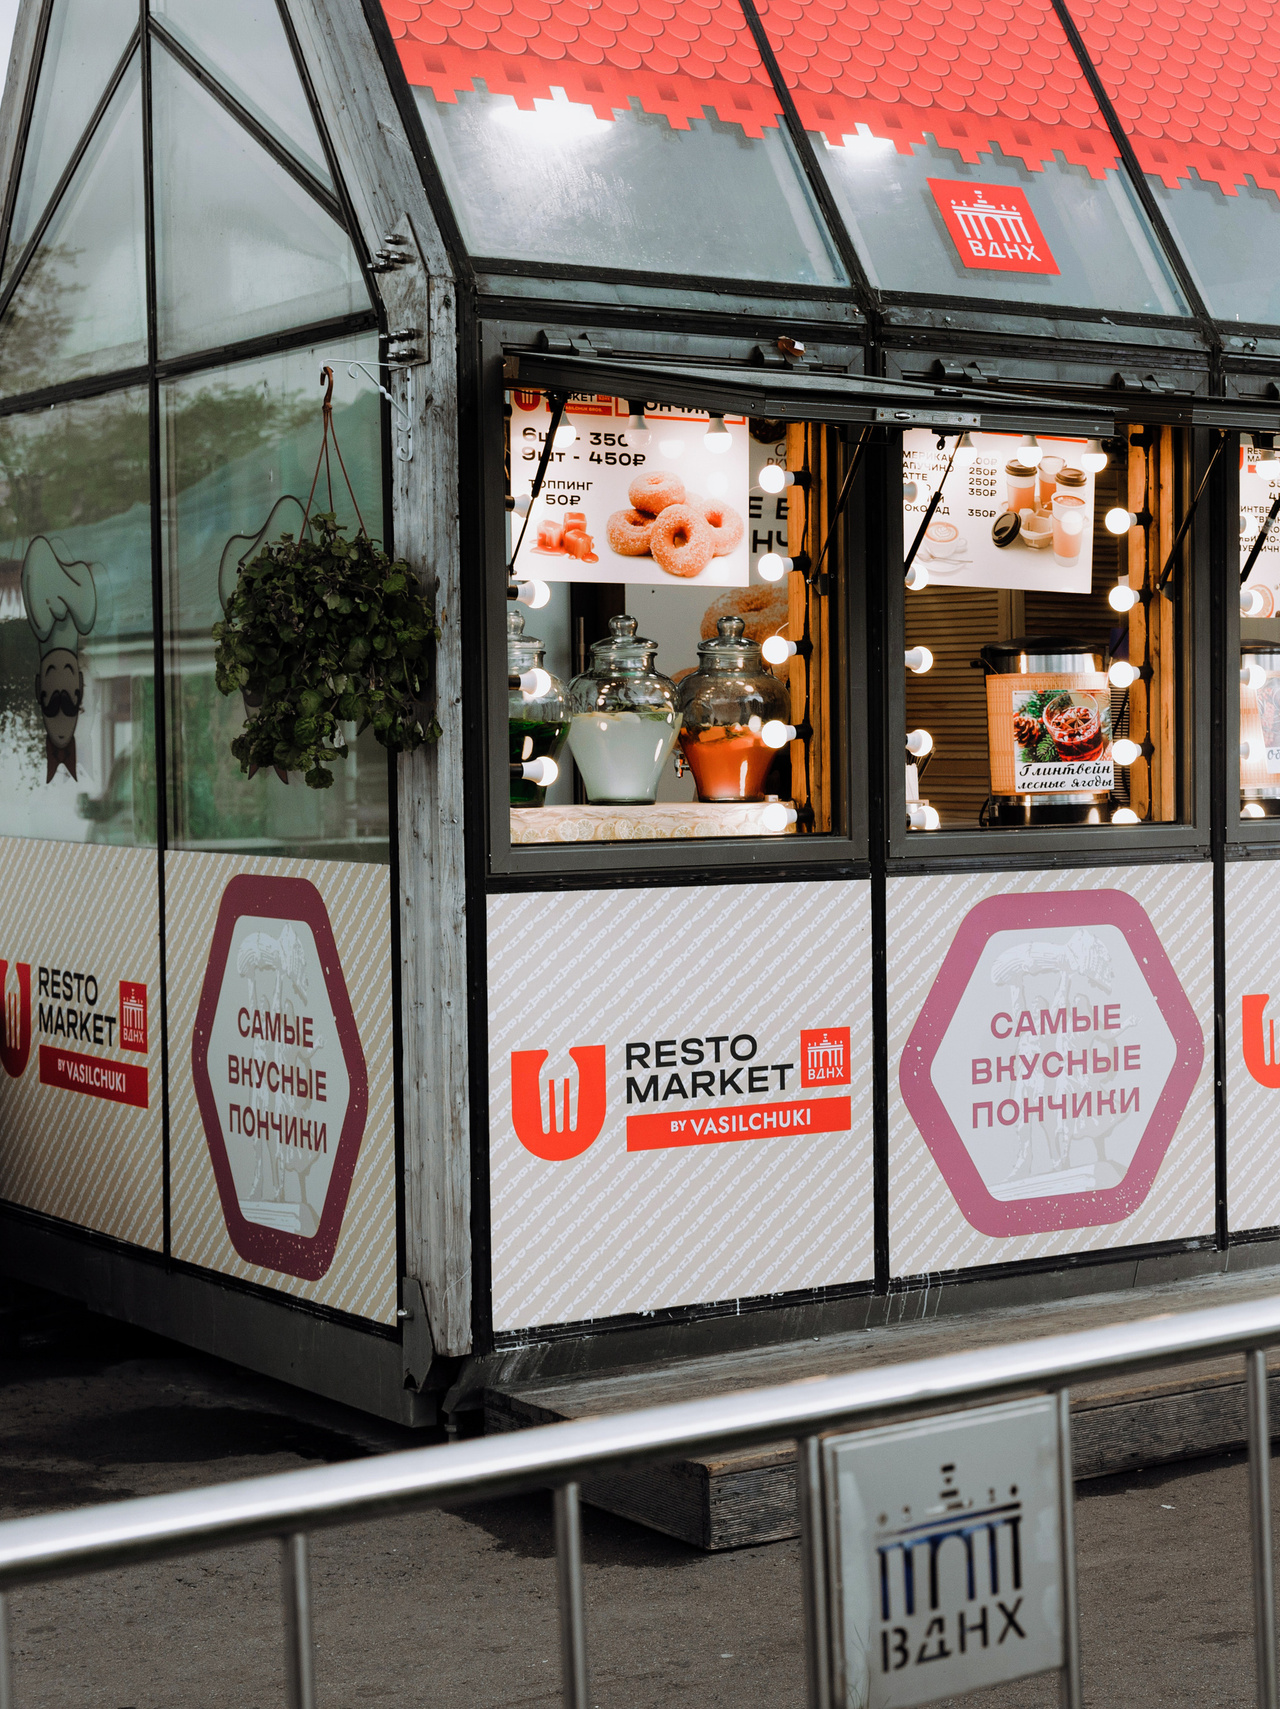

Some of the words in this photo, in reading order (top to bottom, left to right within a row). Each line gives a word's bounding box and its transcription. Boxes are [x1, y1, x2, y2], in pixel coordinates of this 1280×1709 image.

[968, 240, 1041, 261] ВДНХ
[903, 471, 928, 481] АТТЕ
[968, 466, 998, 476] 250₽
[968, 477, 998, 487] 250₽
[546, 494, 581, 505] 50₽
[968, 487, 998, 497] 350₽
[967, 508, 997, 518] 350₽
[1017, 779, 1066, 790] лесные
[1070, 775, 1113, 788] ягоды
[1019, 762, 1112, 777] Глинтвейн
[39, 966, 98, 1006] RESTO
[39, 1003, 117, 1047] MARKET
[123, 1028, 144, 1044] ВДНХ
[238, 1007, 314, 1048] САМЫЕ
[990, 1003, 1122, 1039] САМЫЕ
[626, 1034, 757, 1070] RESTO
[972, 1044, 1141, 1085] ВКУСНЫЕ
[58, 1059, 66, 1072] BY
[66, 1061, 126, 1093] VASILCHUKI
[228, 1054, 327, 1102] ВКУСНЫЕ
[626, 1063, 794, 1104] MARKET
[808, 1066, 845, 1080] ВДНХ
[670, 1120, 686, 1133] BY
[690, 1108, 812, 1136] VASILCHUKI
[972, 1086, 1140, 1129] ПОНЧИКИ
[229, 1103, 327, 1154] ПОНЧИКИ
[882, 1597, 1026, 1674] ВДНХ
